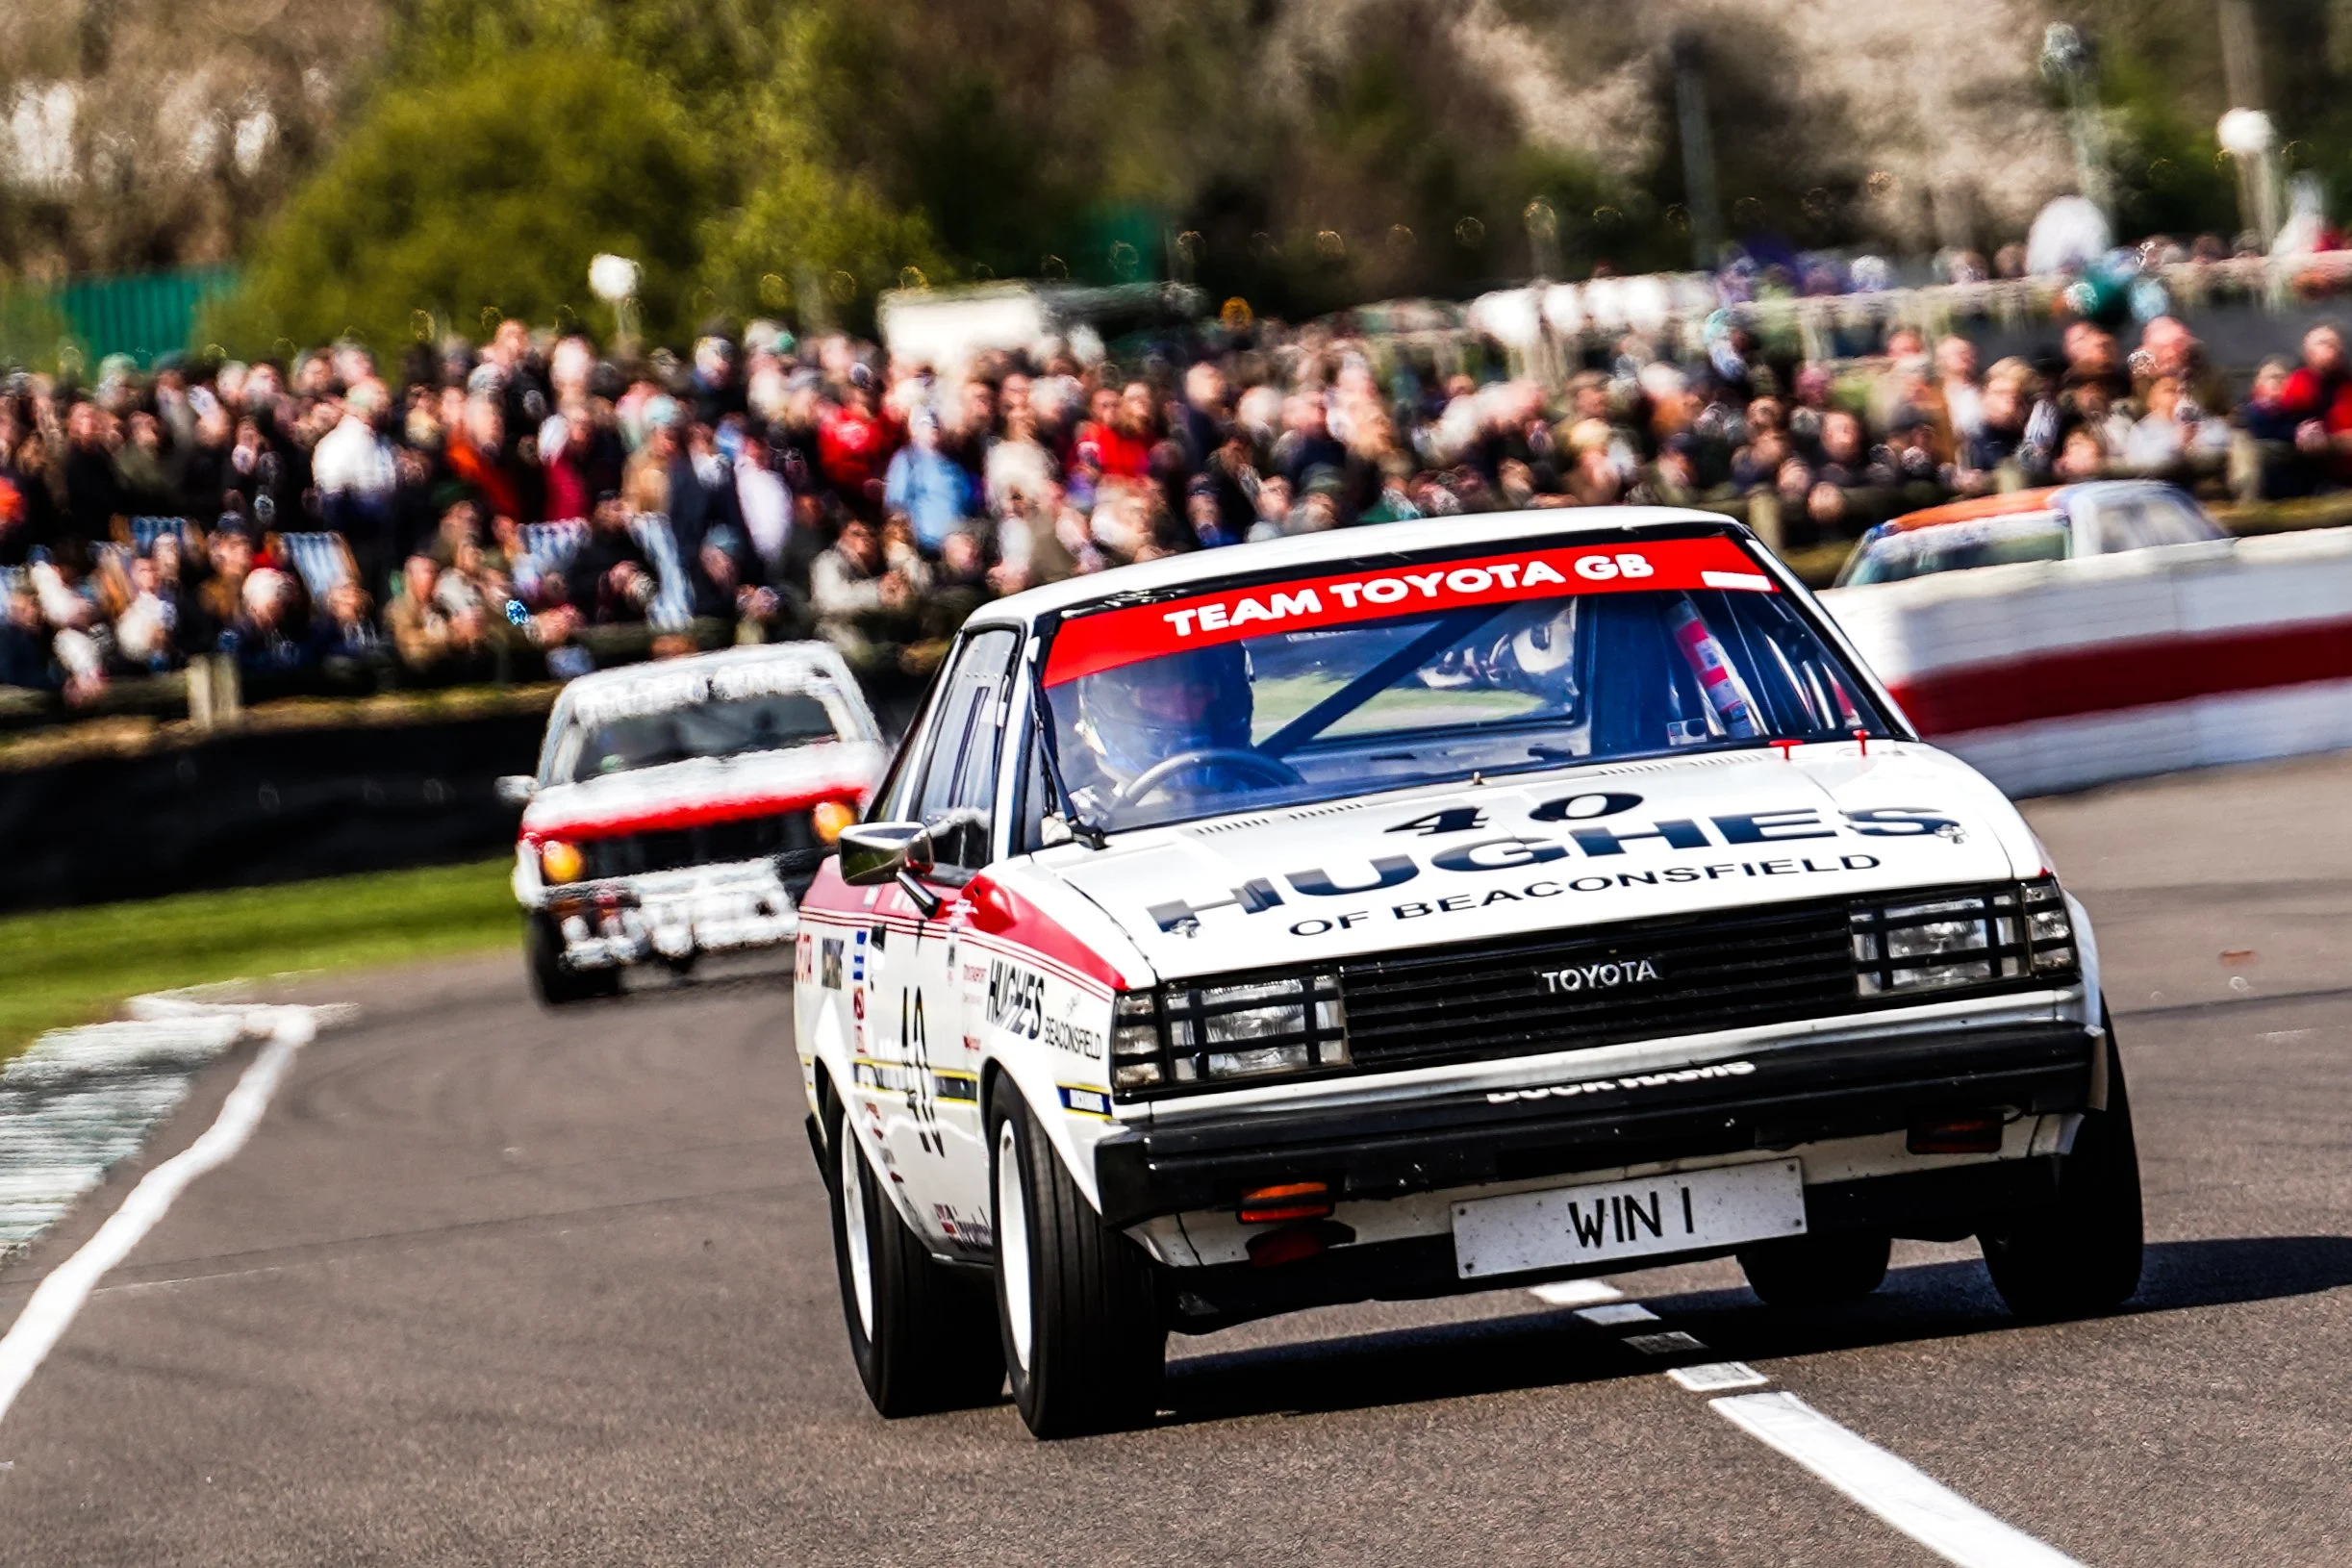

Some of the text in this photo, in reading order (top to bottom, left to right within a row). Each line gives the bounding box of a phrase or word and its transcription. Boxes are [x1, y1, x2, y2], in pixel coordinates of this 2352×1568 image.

[1163, 553, 1655, 637] TEAM TOYOTA GB
[1145, 807, 1961, 935] HUGHES
[1288, 853, 1882, 937] OF BEACONSFIELD
[986, 957, 1045, 1041] HUGHES
[1541, 959, 1659, 994] TOYOTA
[1567, 1190, 1663, 1250] WIN
